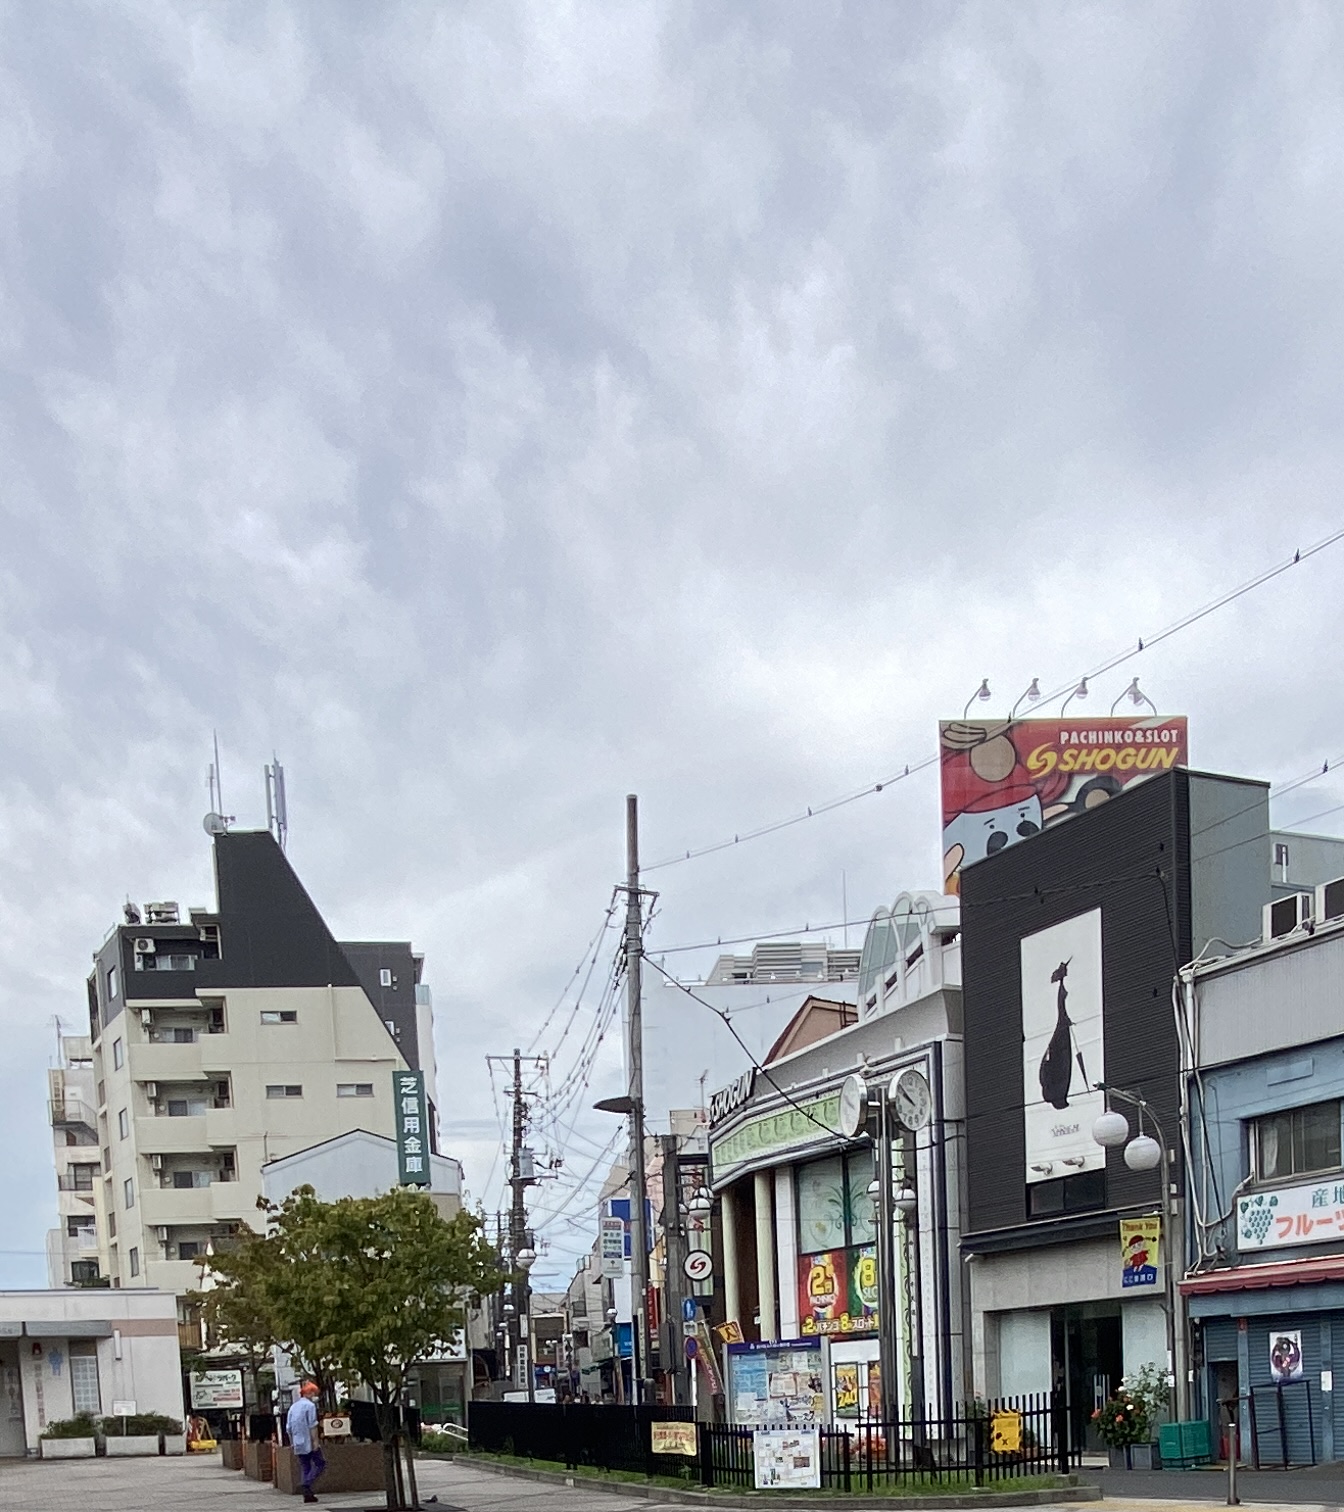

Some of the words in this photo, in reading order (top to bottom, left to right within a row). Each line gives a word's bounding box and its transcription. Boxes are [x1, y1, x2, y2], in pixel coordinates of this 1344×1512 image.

[1060, 729, 1178, 745] PACHINKO&SLOT
[1058, 747, 1178, 771] SHOGUN
[400, 1076, 424, 1173] 芝信用金庫
